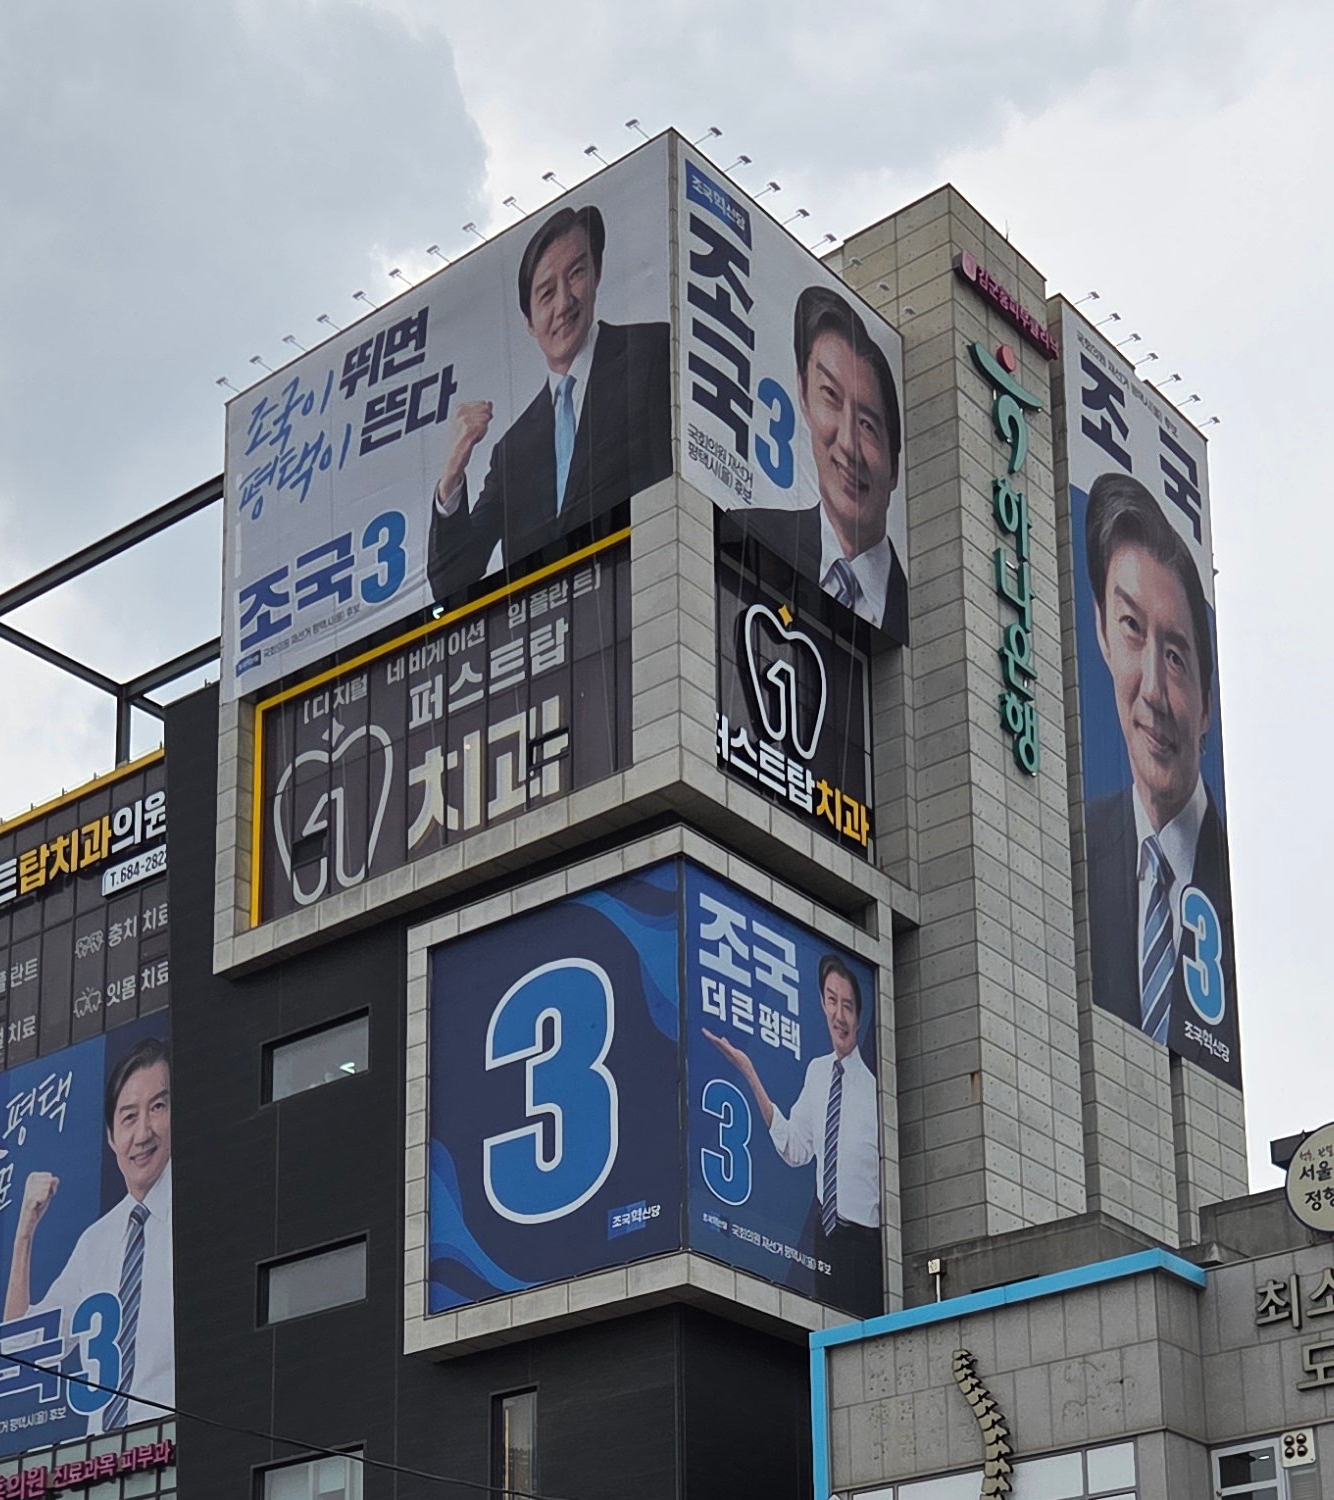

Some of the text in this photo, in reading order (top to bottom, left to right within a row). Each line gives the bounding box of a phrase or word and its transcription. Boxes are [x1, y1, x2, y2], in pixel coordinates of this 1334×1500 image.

[339, 306, 429, 399] 뛰면
[687, 212, 755, 462] 조국
[237, 362, 459, 521] 평택이 뜬다
[755, 378, 796, 490] 3
[1080, 351, 1203, 546] 조국
[239, 508, 408, 652] 조국 3
[993, 476, 1040, 777] 하나은행
[407, 619, 569, 729] 퍼스트탑
[407, 694, 569, 850] 치과
[105, 975, 137, 1008] 잇몸
[698, 892, 801, 1016] 조국
[1181, 887, 1226, 1026] 3
[7, 1015, 37, 1045] 치료
[700, 976, 802, 1061] 더 큰 평택
[483, 957, 619, 1225] 3
[700, 1078, 753, 1206] 3
[611, 1203, 661, 1229] 조국혁신당
[1299, 1160, 1334, 1182] 서울
[66, 1292, 123, 1416] 3
[52, 1453, 117, 1488] 진료과목
[120, 1440, 172, 1473] 피부과
